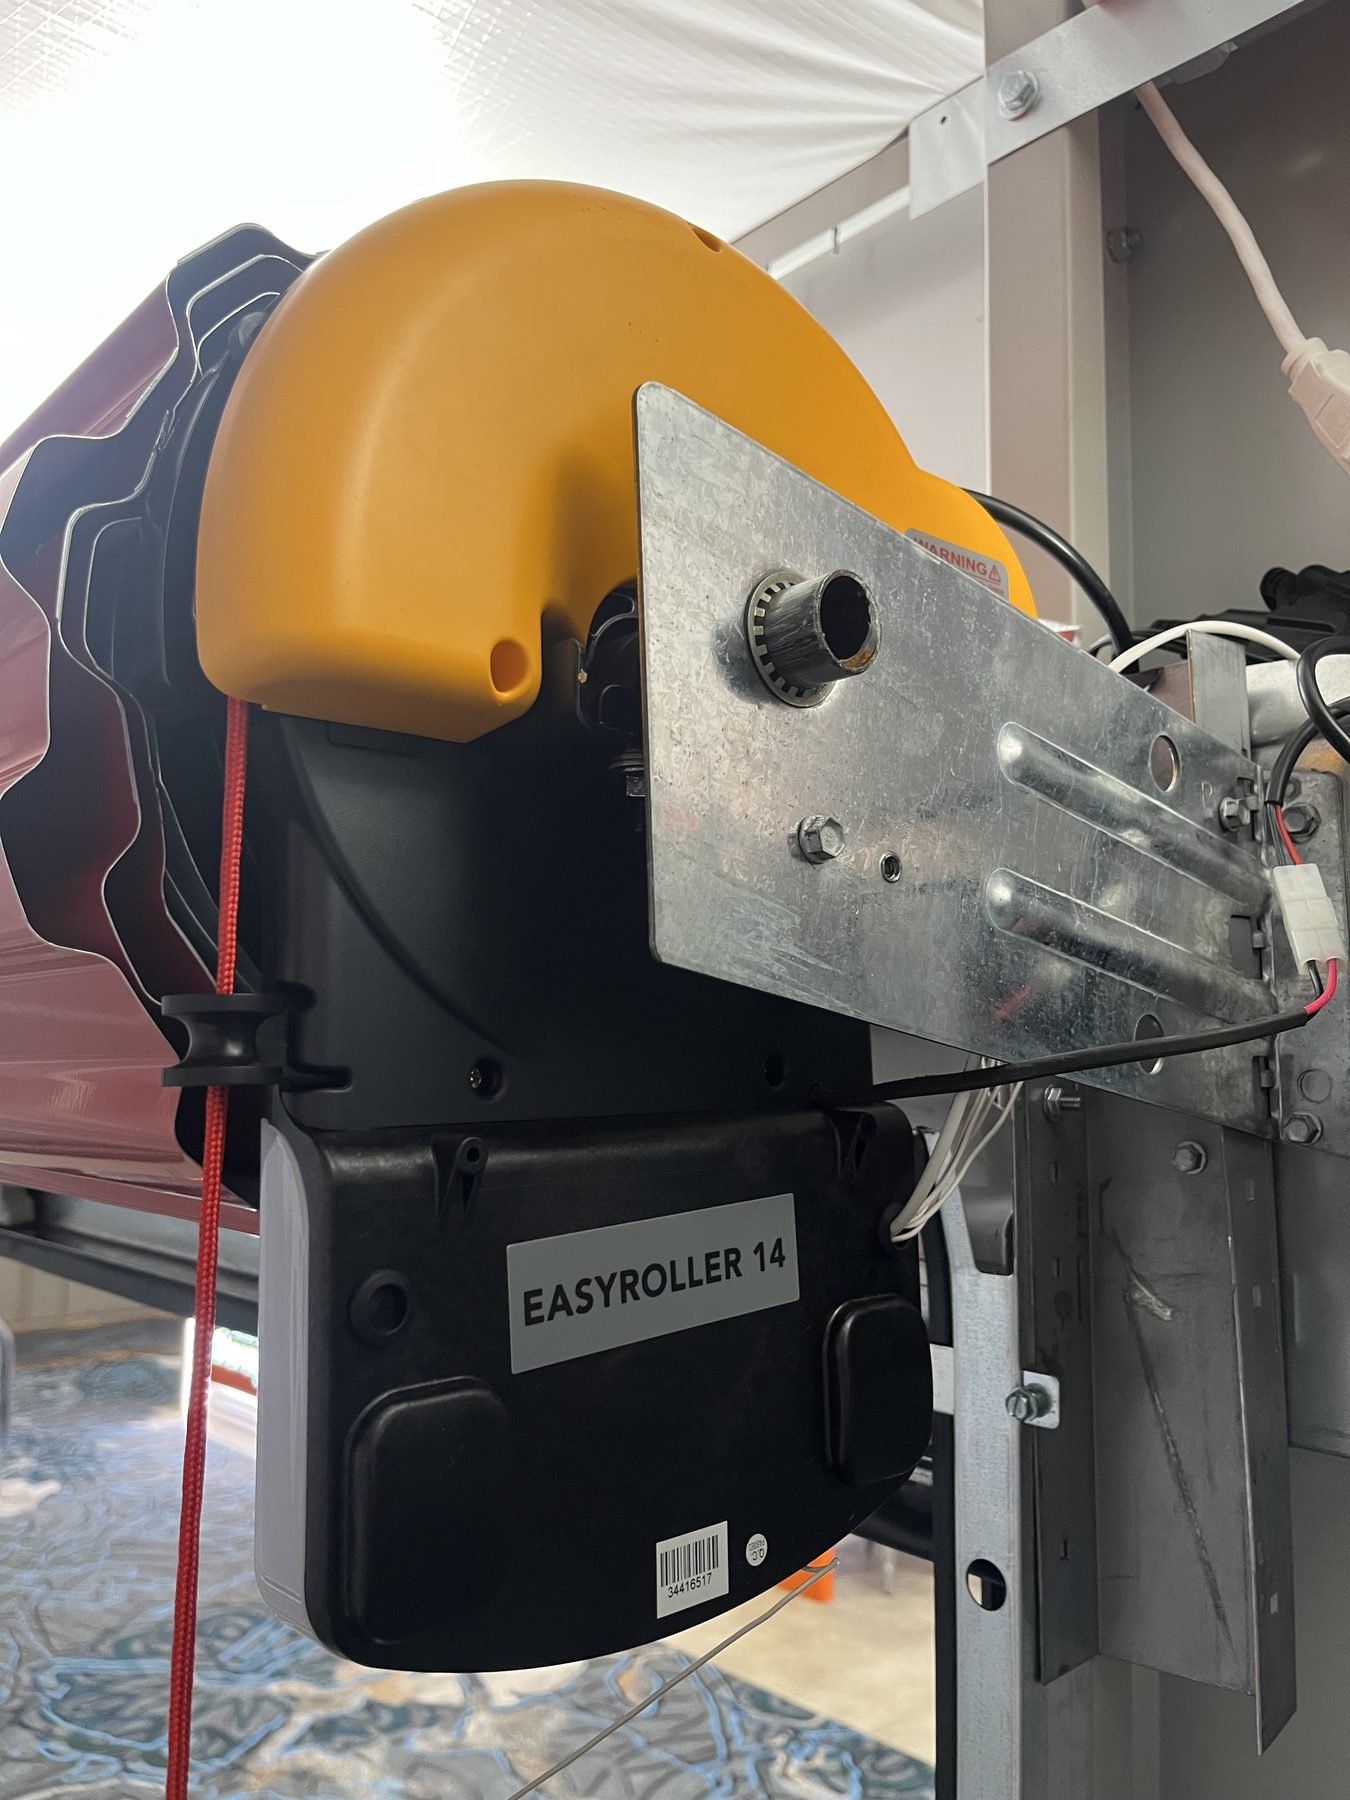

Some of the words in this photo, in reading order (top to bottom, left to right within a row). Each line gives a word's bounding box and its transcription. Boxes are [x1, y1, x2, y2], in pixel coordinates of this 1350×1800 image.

[523, 1247, 743, 1326] EASYROLLER
[753, 1237, 786, 1272] 14
[667, 1572, 712, 1598] 34416517
